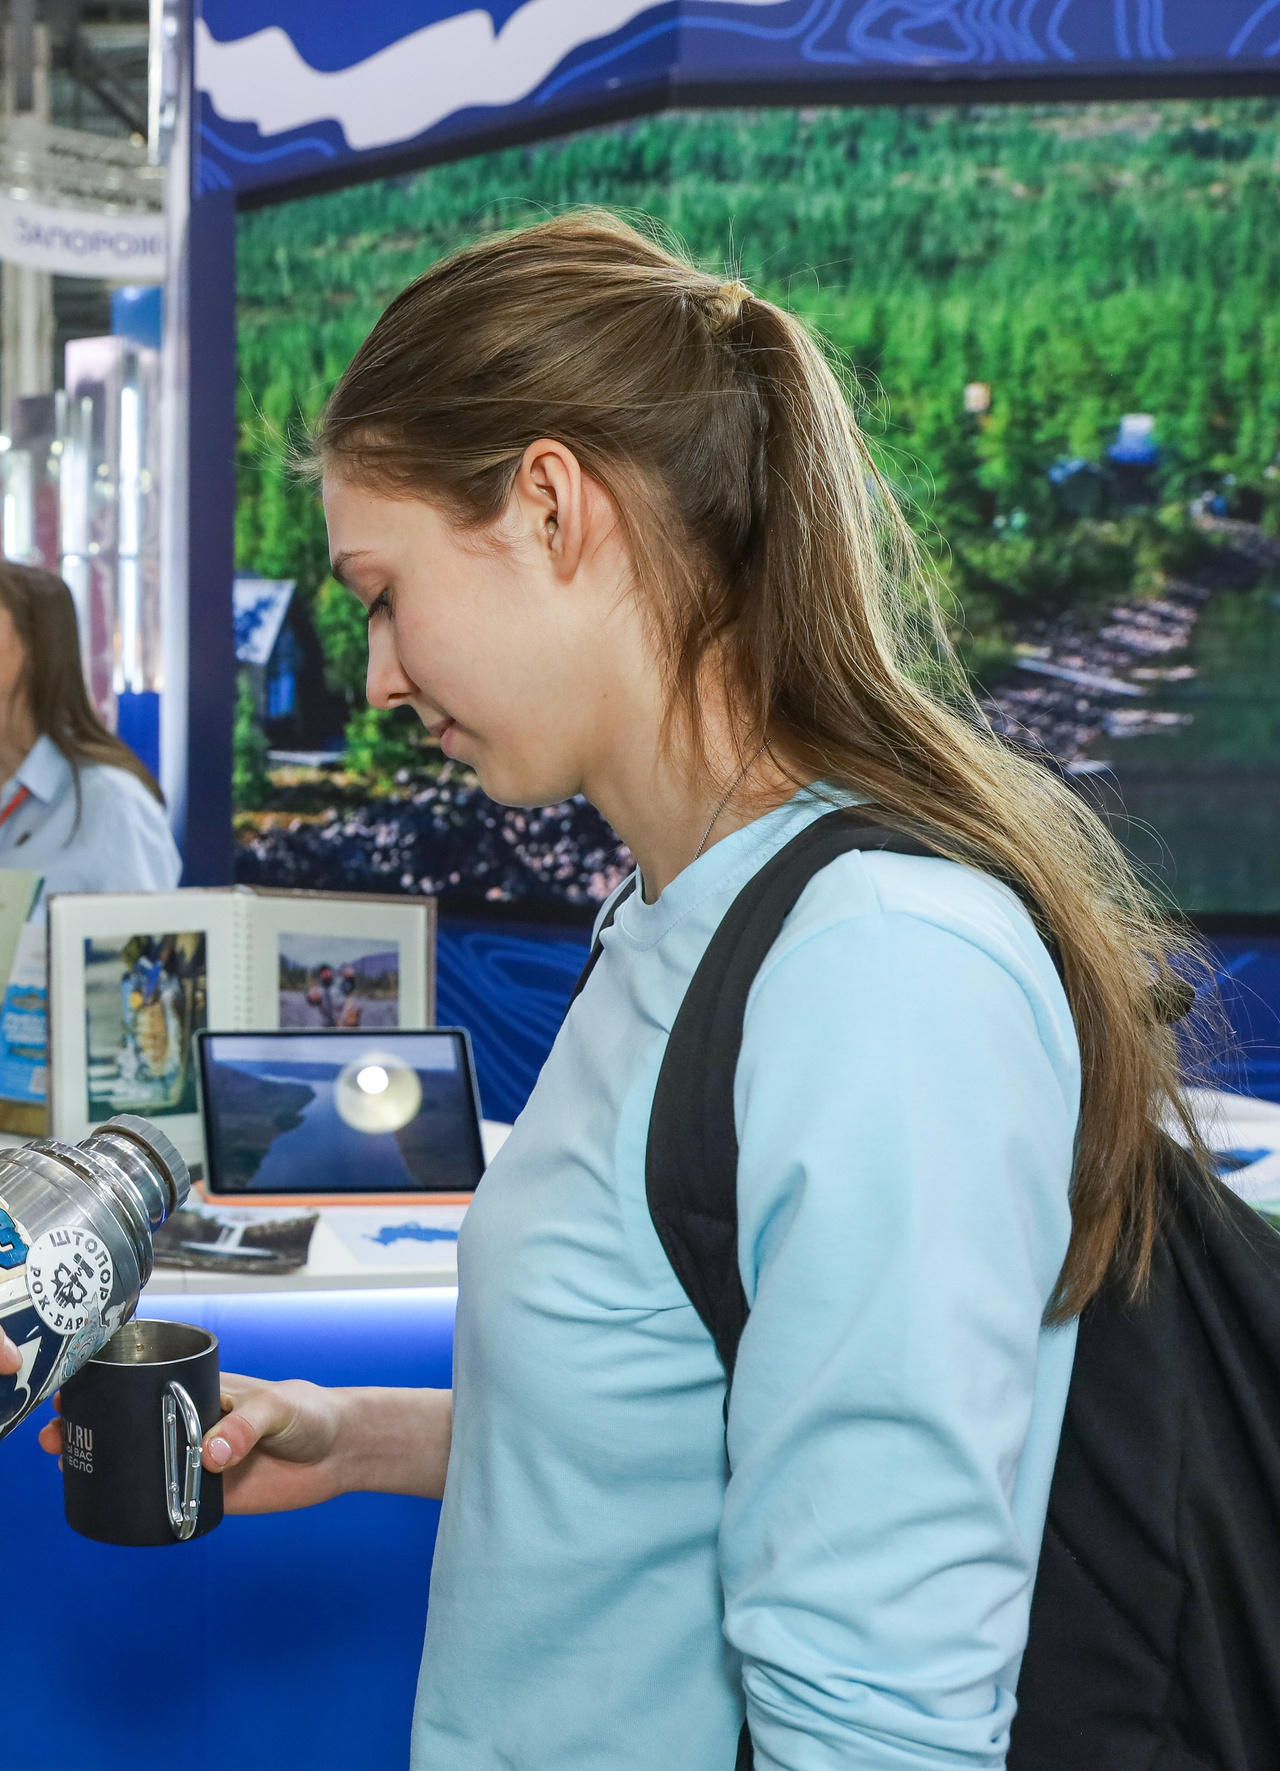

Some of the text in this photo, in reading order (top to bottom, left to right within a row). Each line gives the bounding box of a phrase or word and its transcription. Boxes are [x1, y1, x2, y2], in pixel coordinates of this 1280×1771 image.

[30, 1265, 84, 1330] РОК-БАР
[49, 1229, 111, 1301] ШТОПОР
[74, 1447, 93, 1462] ВАС
